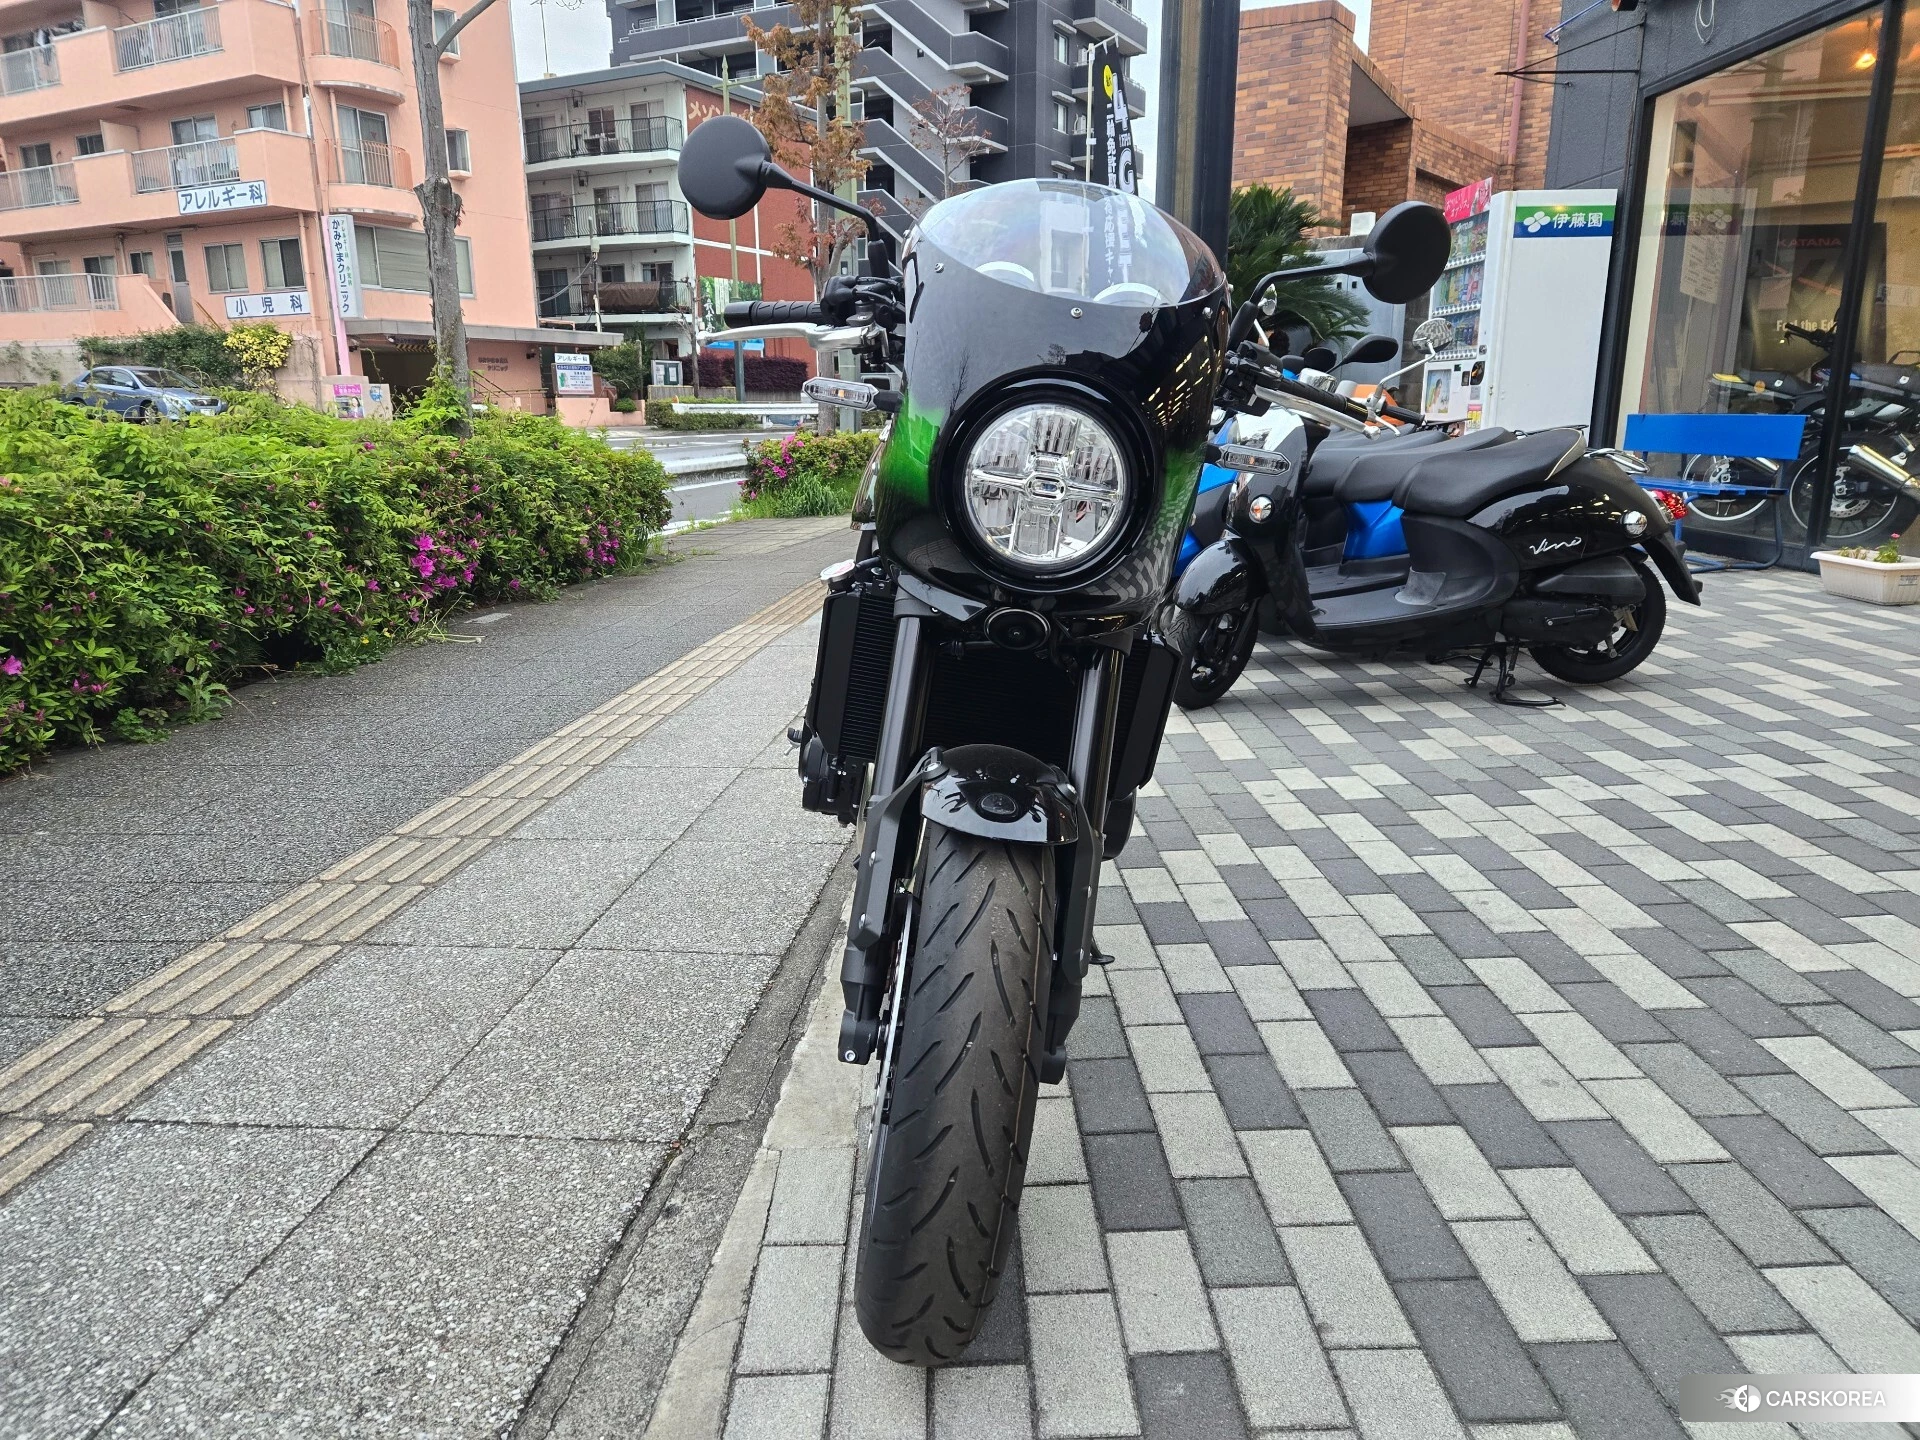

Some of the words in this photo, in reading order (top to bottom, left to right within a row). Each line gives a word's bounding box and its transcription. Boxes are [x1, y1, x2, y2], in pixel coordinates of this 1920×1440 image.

[181, 183, 263, 211] アレルギー科
[1552, 212, 1604, 229] 伊藤園
[1779, 237, 1842, 247] KATANA
[331, 219, 349, 313] かみやまクリニック
[236, 294, 303, 316] 小児科
[1800, 319, 1818, 331] the
